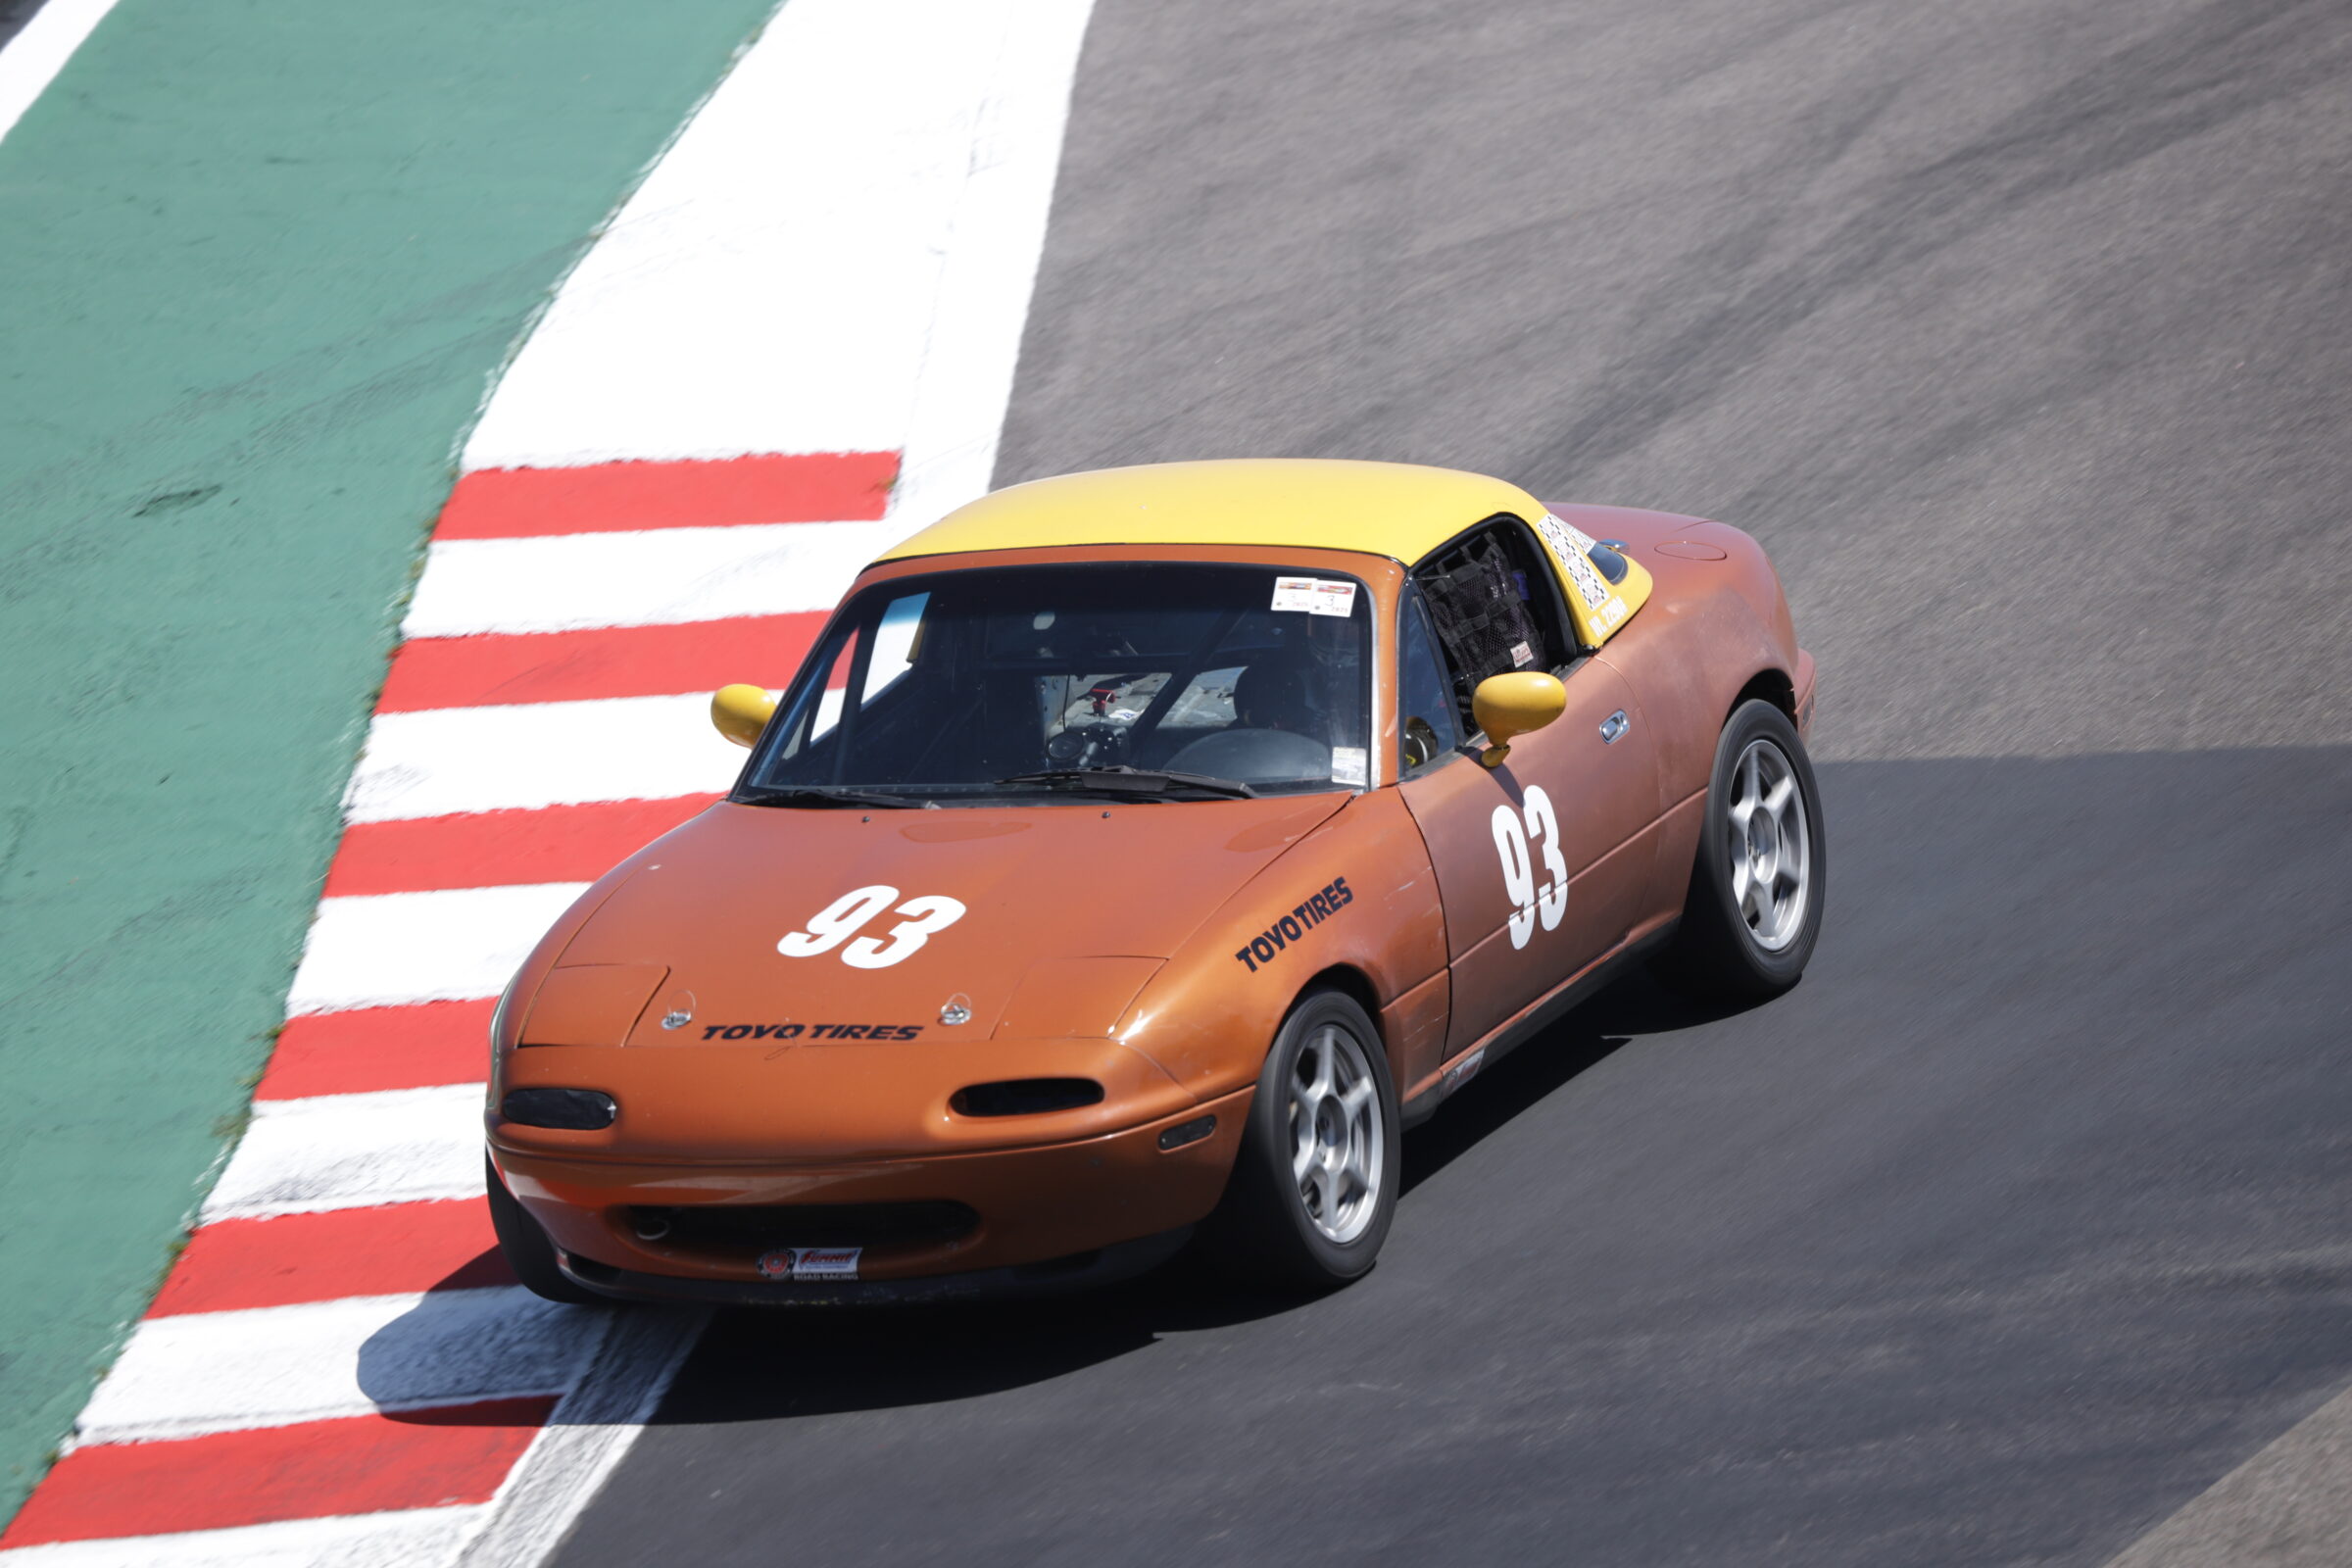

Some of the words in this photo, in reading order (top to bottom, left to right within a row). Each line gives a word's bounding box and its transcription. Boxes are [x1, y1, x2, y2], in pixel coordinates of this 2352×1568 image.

[1492, 785, 1568, 951] 93
[777, 885, 966, 969] 93
[1235, 915, 1302, 973] TOYO
[1292, 876, 1353, 930] TIRES
[701, 1024, 806, 1041] TOYO
[809, 1024, 924, 1041] TIRES
